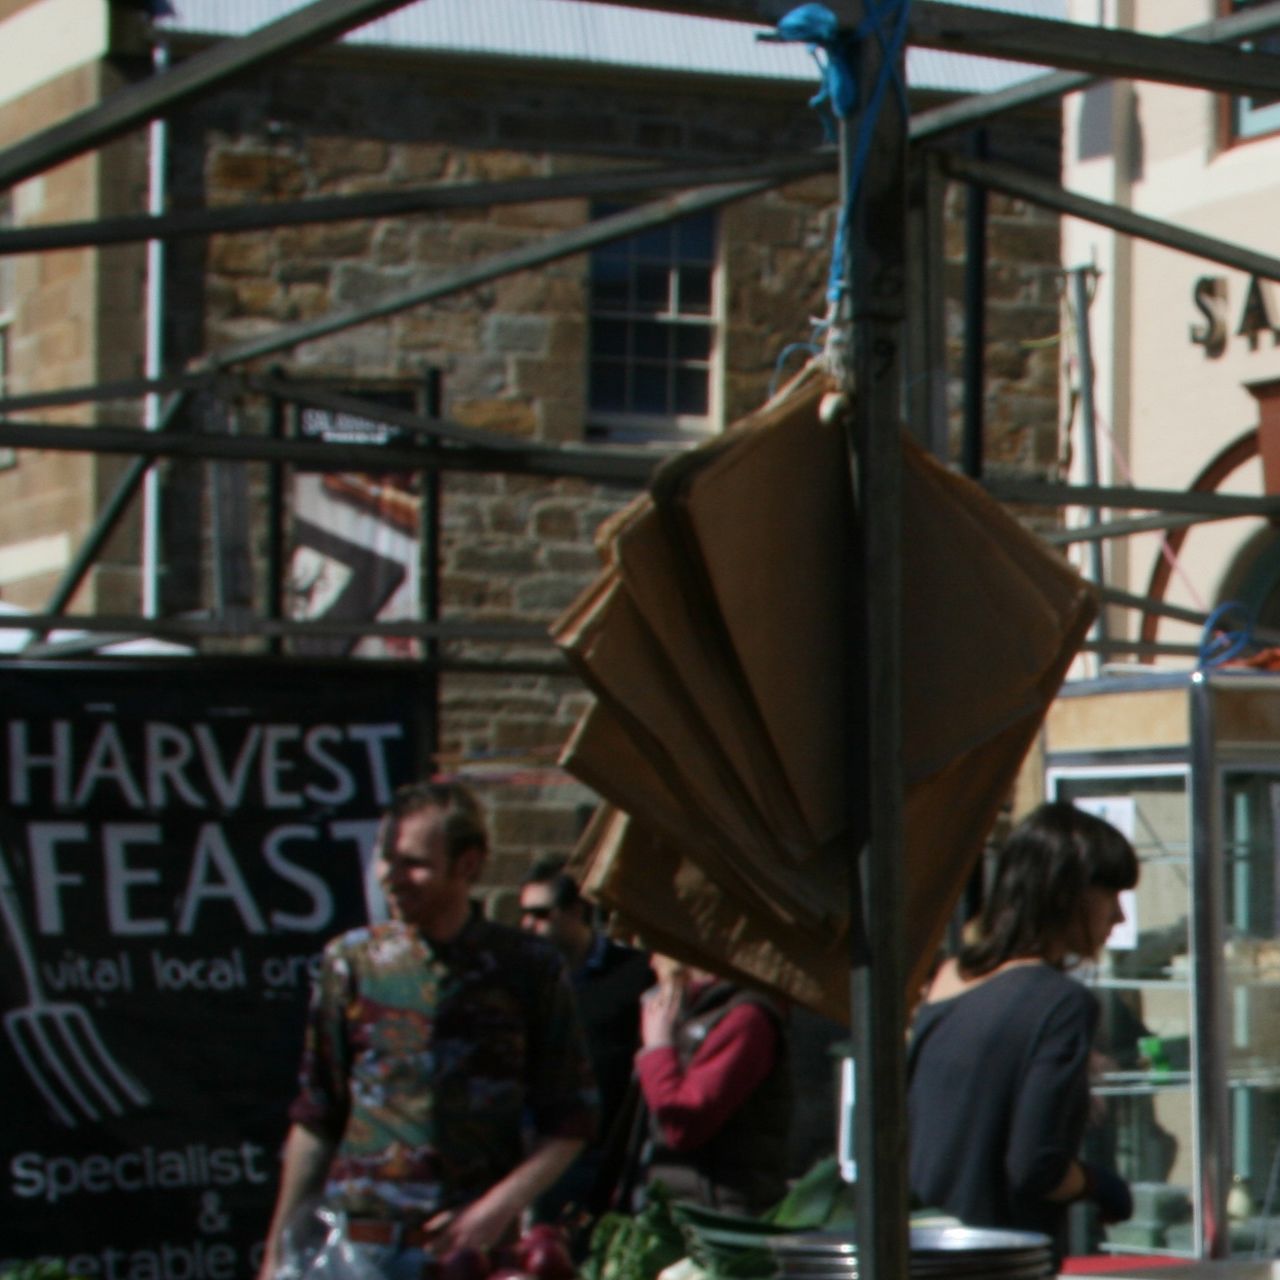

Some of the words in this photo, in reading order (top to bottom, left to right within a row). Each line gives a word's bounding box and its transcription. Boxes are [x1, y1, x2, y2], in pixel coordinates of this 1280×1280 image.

[8, 718, 402, 808] HARVEST
[27, 821, 392, 936] FEAST
[46, 950, 132, 994] vital
[152, 948, 247, 991] local
[10, 1142, 268, 1202] Specialist
[200, 1192, 230, 1234] &
